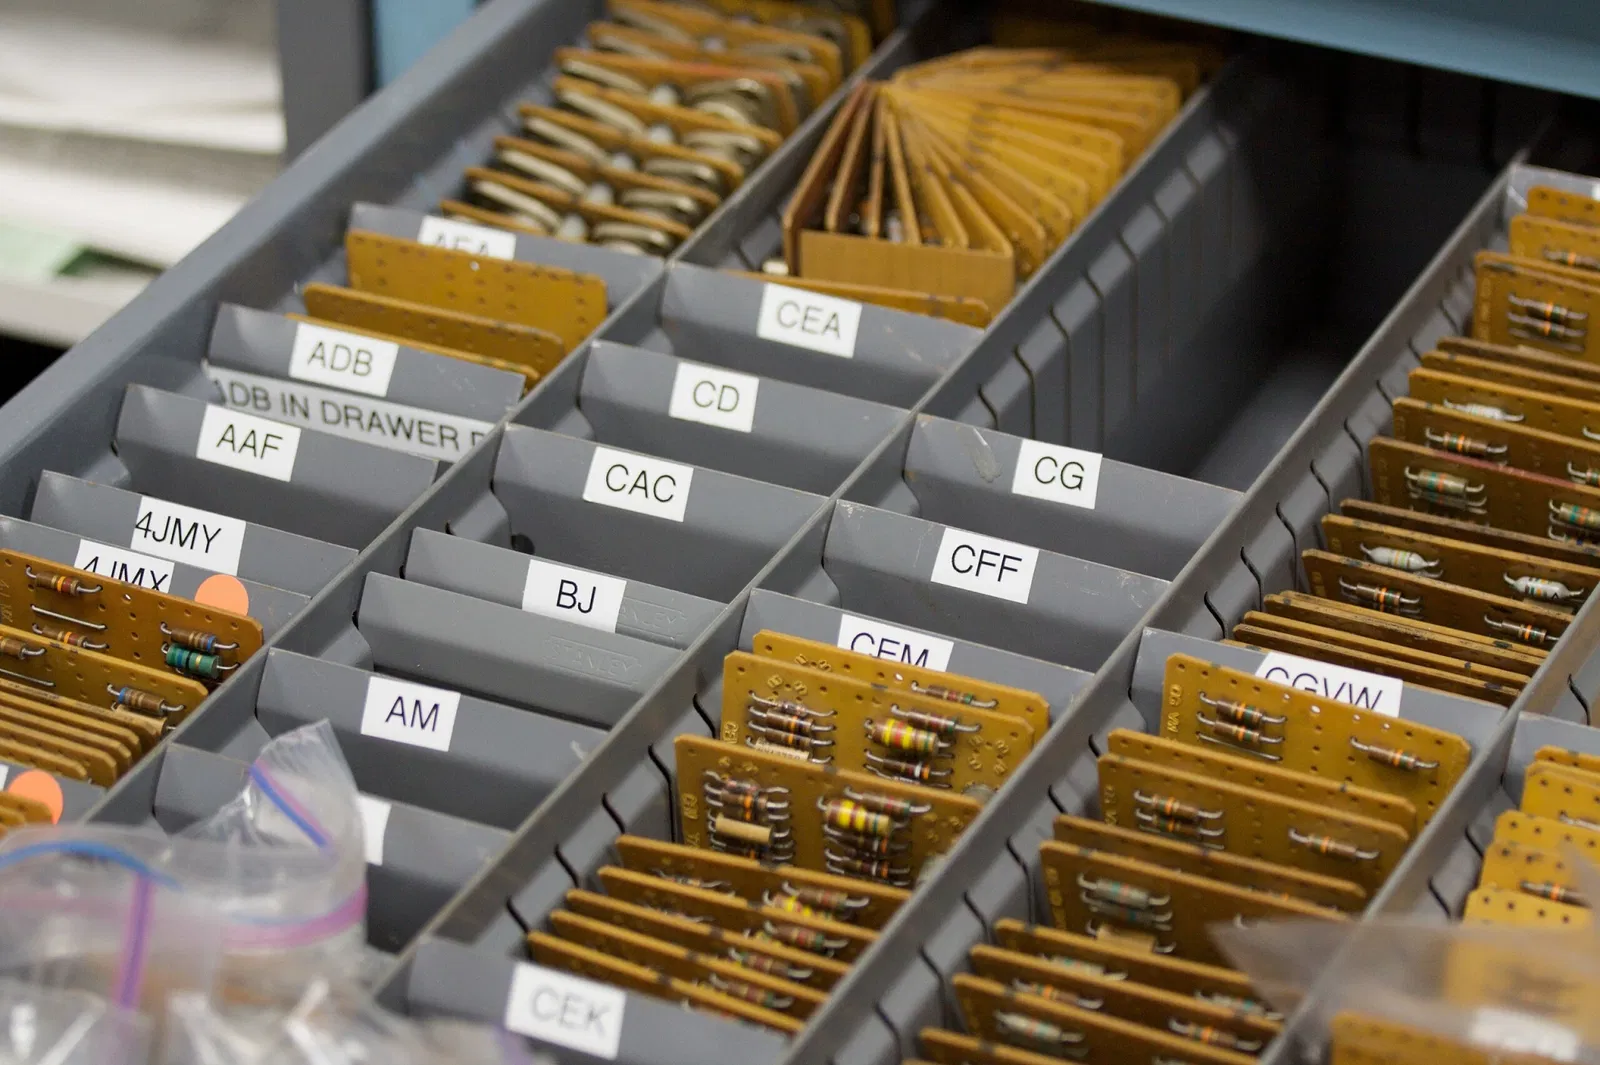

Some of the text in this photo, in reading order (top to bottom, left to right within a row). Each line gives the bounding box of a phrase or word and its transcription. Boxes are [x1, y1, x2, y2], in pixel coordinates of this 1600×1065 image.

[776, 300, 842, 340] CEA
[307, 340, 374, 378] ADB
[692, 380, 740, 413] CD
[216, 423, 284, 460] AAF
[281, 393, 311, 420] IN
[321, 400, 461, 452] DRAWER
[605, 463, 677, 503] CAC
[1034, 456, 1085, 491] CG
[135, 511, 222, 554] 4JMY
[951, 544, 1023, 582] CFF
[555, 578, 598, 614] BJ
[385, 695, 440, 733] AM
[529, 983, 611, 1038] CEK
